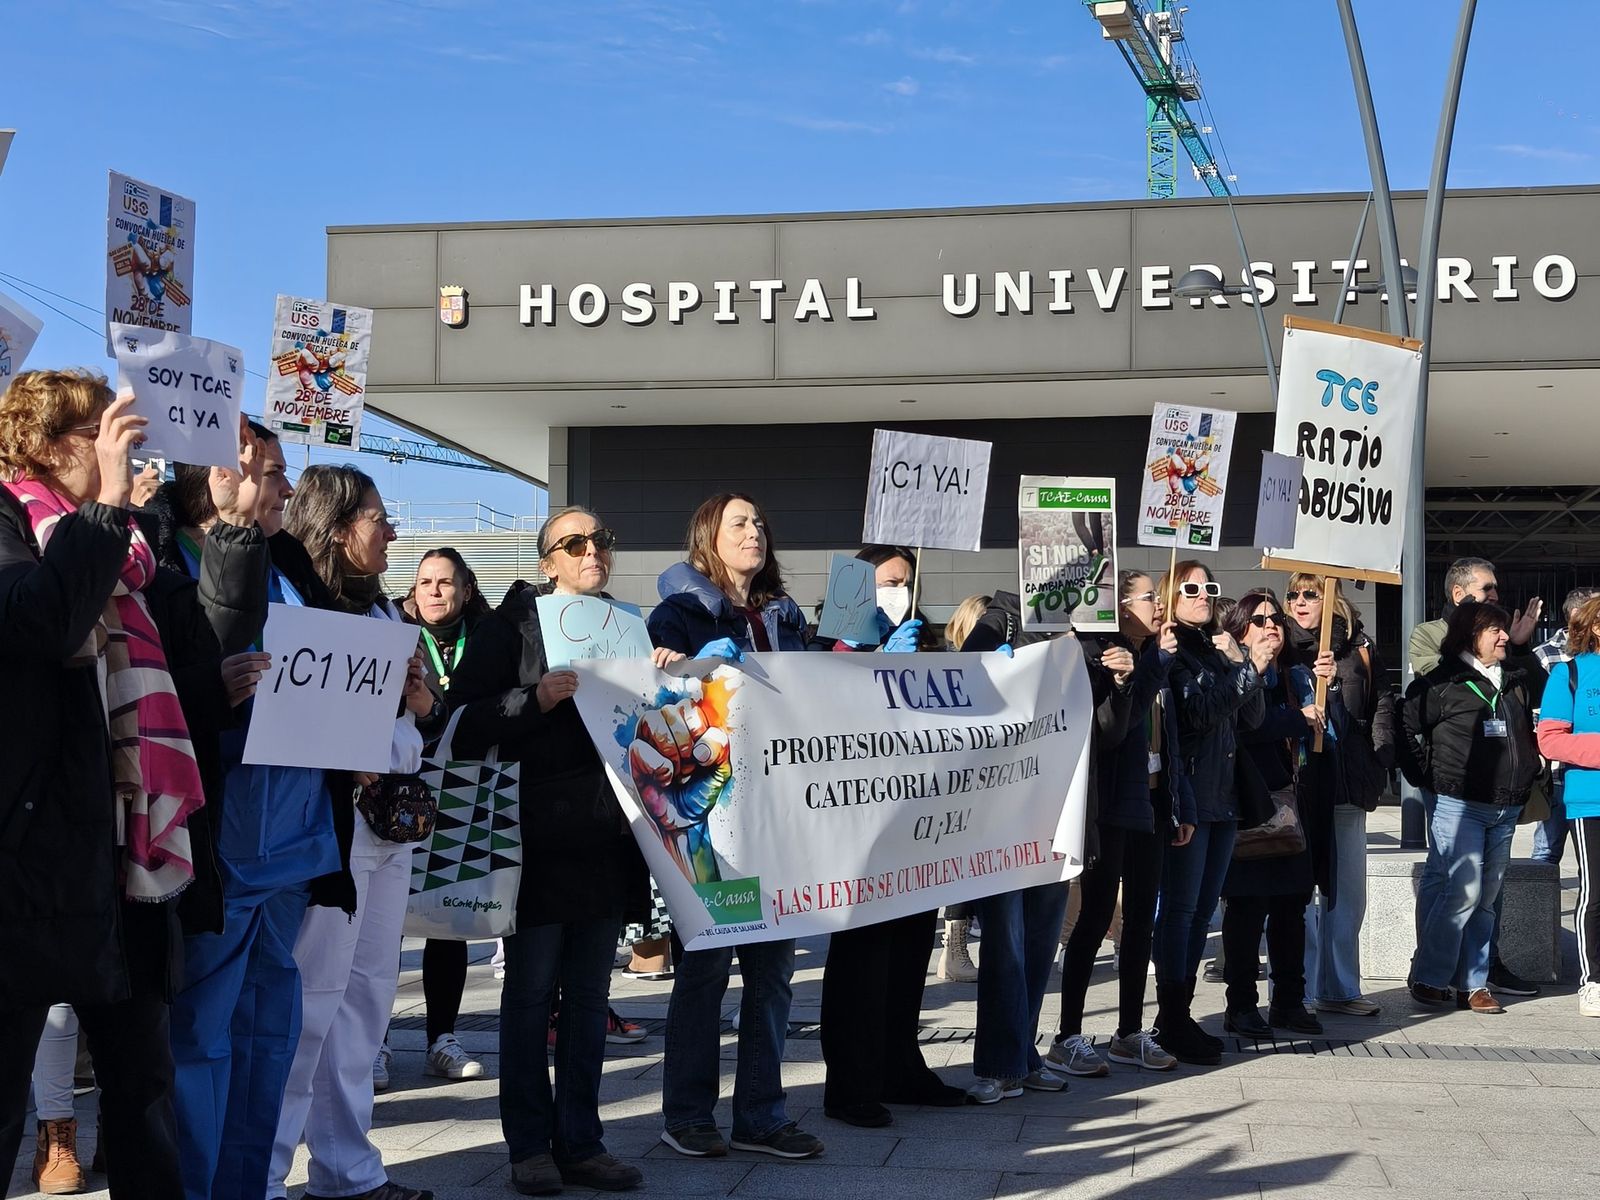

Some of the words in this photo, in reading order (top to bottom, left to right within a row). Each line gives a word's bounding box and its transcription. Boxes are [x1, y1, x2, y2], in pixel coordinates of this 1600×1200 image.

[115, 218, 150, 237] CONVOCAN
[152, 229, 176, 246] HUELGA
[177, 239, 185, 250] DE
[519, 277, 876, 326] HOSPITAL
[942, 254, 1579, 315] UNIVERSITRIO
[130, 295, 145, 312] 28
[148, 299, 165, 317] DE
[281, 330, 320, 344] CONVOCAN
[322, 336, 348, 349] HUELGA
[350, 342, 359, 351] DE
[311, 345, 329, 355] TCAE
[148, 367, 183, 388] SOY
[190, 373, 232, 399] TCAE
[1316, 369, 1379, 415] TCE
[295, 390, 311, 402] 28
[315, 391, 333, 405] DE
[168, 406, 185, 424] C1
[193, 409, 220, 429] YA
[1156, 437, 1189, 449] CONVOCAN
[1190, 441, 1213, 451] HUELGA
[1214, 444, 1222, 452] DE
[1180, 449, 1195, 458] TCAE
[882, 461, 922, 494] ¡C1
[933, 464, 970, 495] YA!
[1040, 491, 1108, 504] TCAE-Causa
[1164, 493, 1177, 506] 28
[1180, 495, 1197, 507] DE
[1262, 477, 1276, 506] ¡C1
[1278, 478, 1292, 502] YA!
[1029, 545, 1047, 566] SI
[1051, 544, 1090, 565] NOS
[1030, 566, 1090, 580] MOVEMOS
[833, 563, 872, 610] C1
[1025, 577, 1086, 593] CAMBIAMOS
[1027, 586, 1099, 623] TODO
[273, 647, 333, 693] ¡C1
[345, 654, 392, 695] YA!
[874, 668, 972, 709] TCAE
[763, 727, 963, 776] ¡PROFESIONALES
[967, 725, 997, 750] DE
[1001, 709, 1067, 747] PRIMERA!
[805, 771, 941, 809] CATEGORIA
[947, 769, 974, 795] DE
[976, 754, 1040, 791] SEGUNDA
[935, 808, 971, 844] ¡YA!
[773, 885, 812, 925] ¡LAS
[817, 876, 874, 910] LEYES
[877, 872, 893, 899] SE
[897, 856, 963, 894] CUMPLEN!
[1013, 840, 1046, 868] DEL
[452, 897, 472, 908] Corte
[473, 896, 502, 912] Inglés
[703, 890, 757, 908] e-Causa
[738, 922, 768, 932] SALAMANCA
